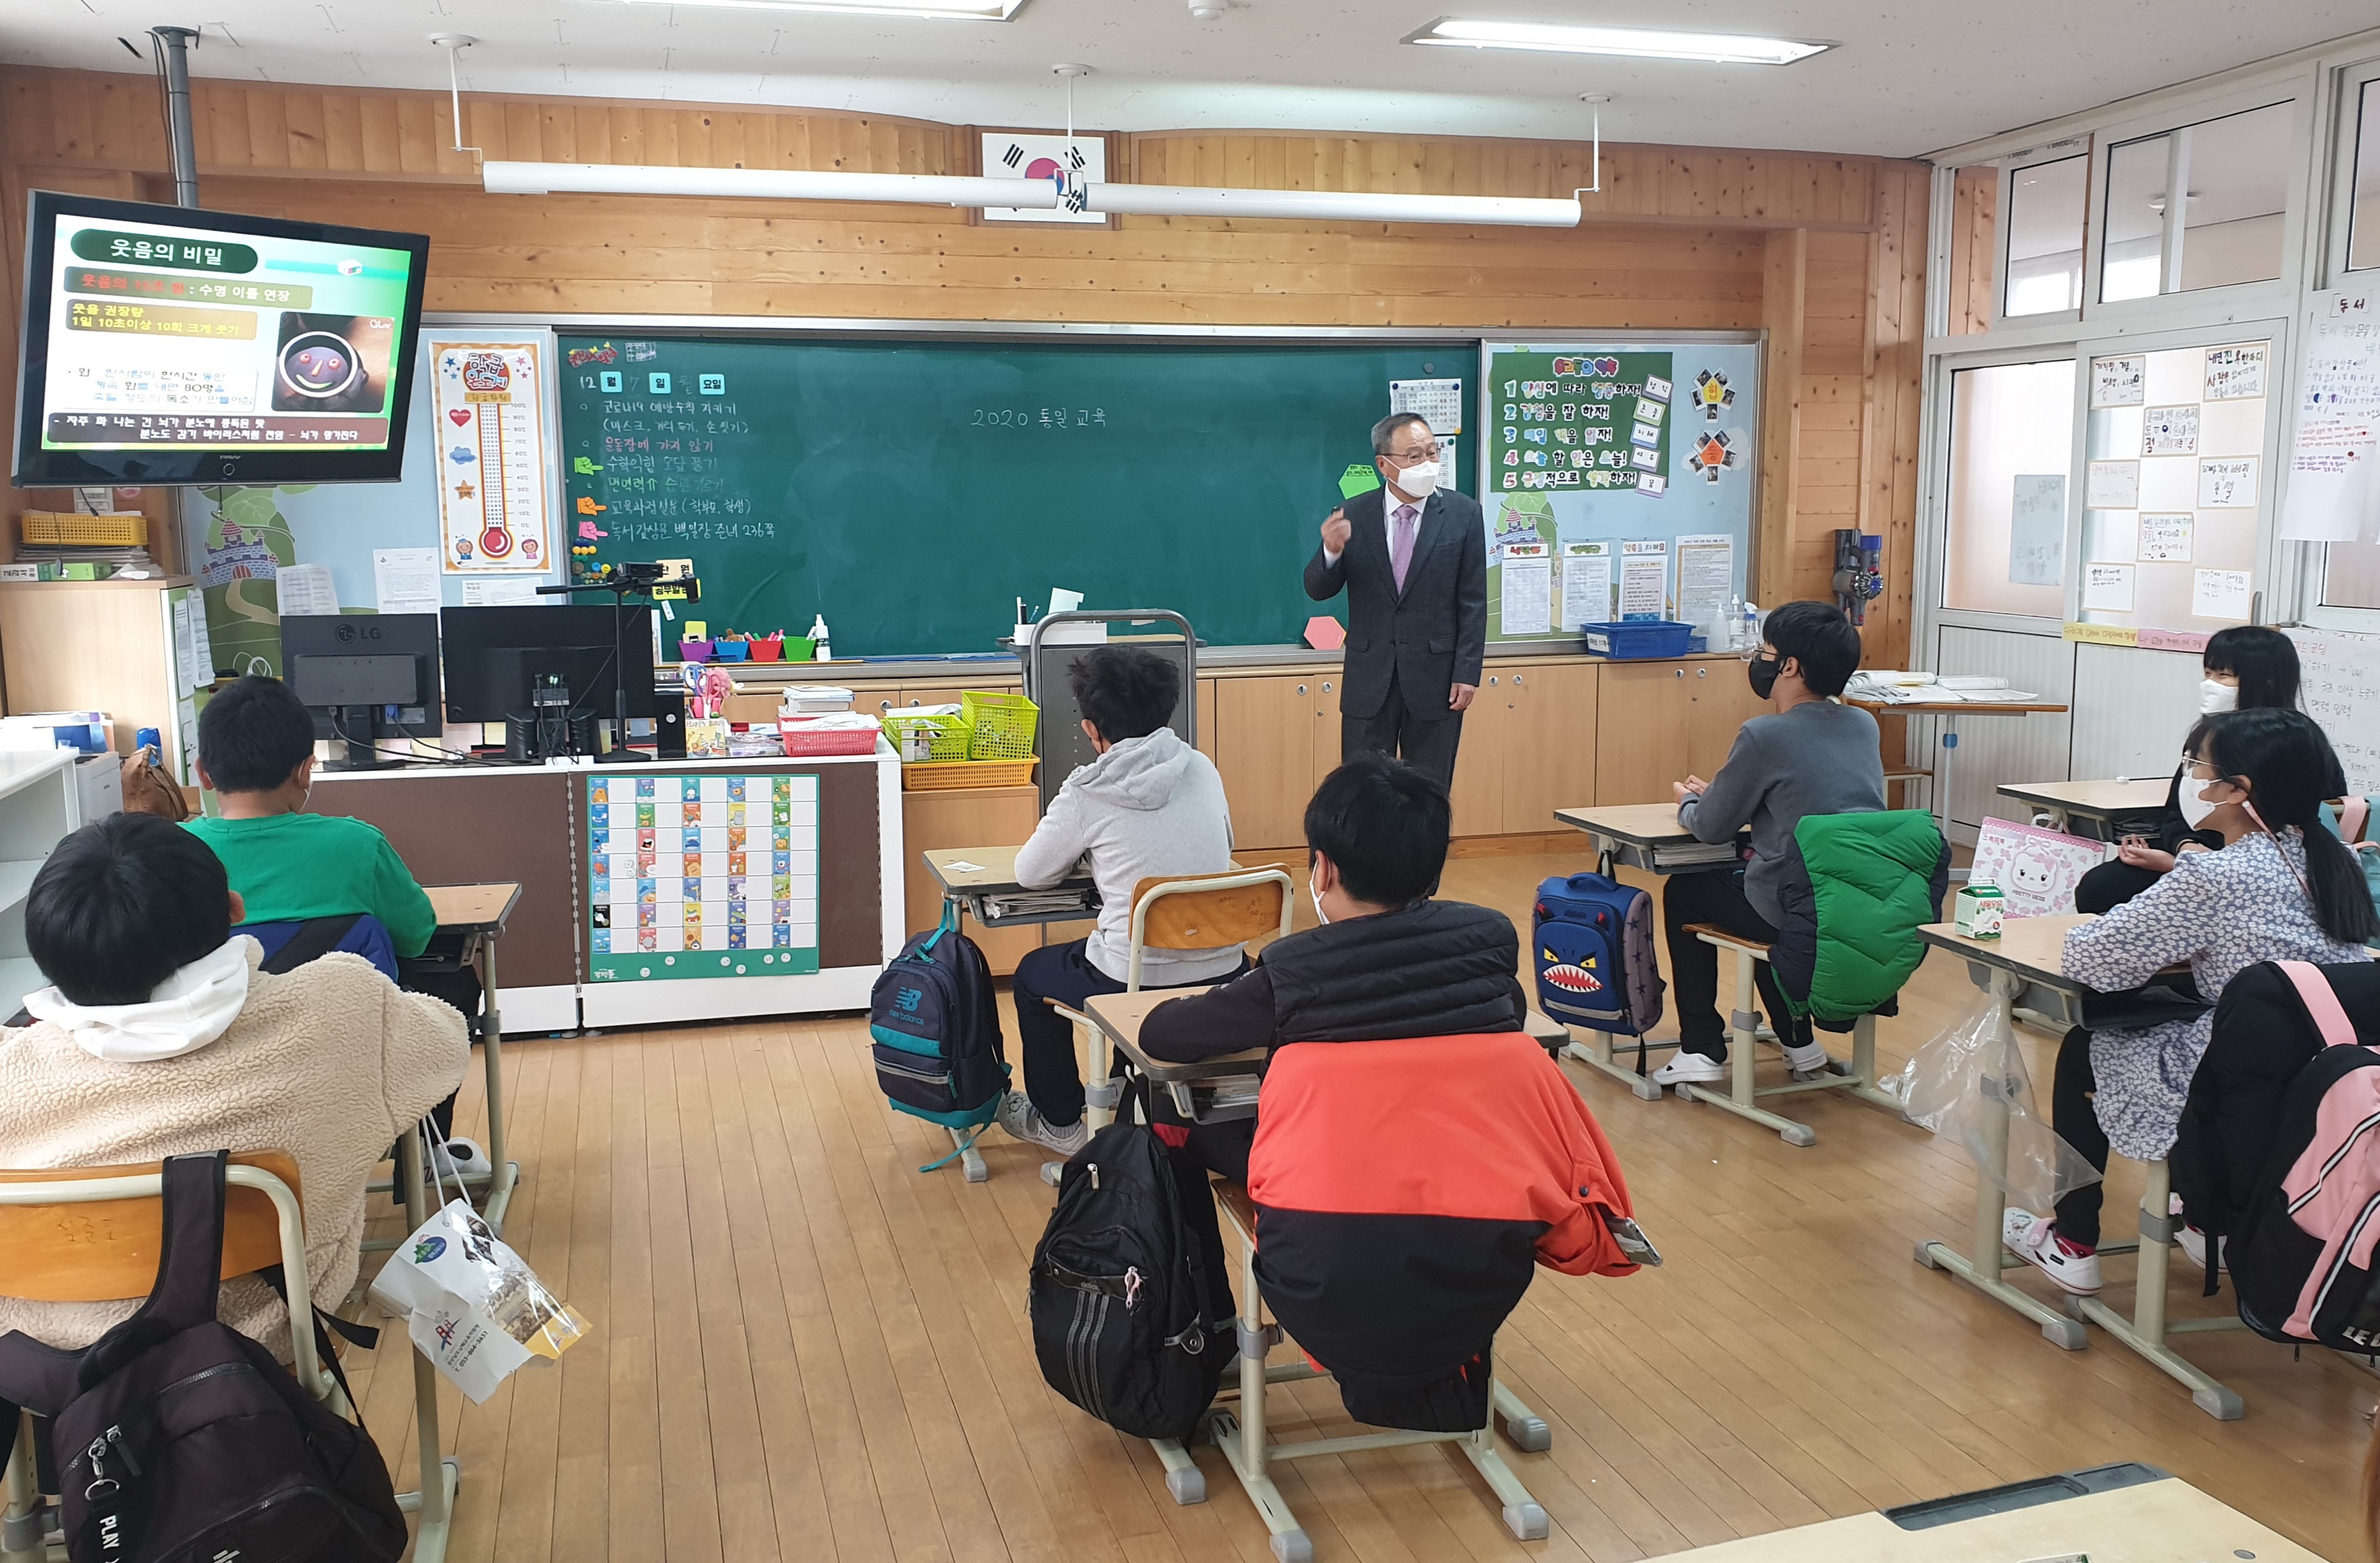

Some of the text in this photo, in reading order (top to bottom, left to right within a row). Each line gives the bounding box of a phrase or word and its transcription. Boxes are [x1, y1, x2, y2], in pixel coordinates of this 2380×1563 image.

[110, 238, 222, 266] 웃음의 비밀
[82, 274, 127, 289] 웃음의
[199, 284, 227, 298] 수명
[264, 288, 290, 302] 연장
[73, 303, 144, 318] 웃음 권장량
[72, 316, 239, 336] 1일 10초이상 10회 크게 웃기
[468, 353, 503, 374] 학급
[161, 371, 197, 381] 한시간
[466, 371, 507, 388] 온도계
[580, 376, 597, 388] 12
[656, 378, 665, 388] 일
[703, 379, 721, 390] 요일
[1505, 381, 1641, 399] 1 양심에 따라 행동하자!
[603, 400, 737, 415] 코로나19 예방수칙 지키기
[1504, 405, 1517, 420] 2
[1563, 405, 1574, 420] 잘
[1583, 405, 1609, 419] 하자!
[66, 416, 88, 427] 자주
[95, 416, 107, 427] 화
[114, 416, 135, 427] 나는
[142, 417, 152, 427] 건
[158, 417, 179, 427] 뇌가
[186, 418, 215, 428] 분노에
[971, 407, 1106, 429] 2020 통일 교육
[140, 429, 170, 439] 분노도
[177, 429, 196, 440] 감기
[203, 430, 260, 440] 바이러스처럼
[265, 430, 284, 440] 전염
[300, 431, 318, 440] 뇌가
[1504, 427, 1517, 443] 3
[1524, 429, 1547, 444] 매일
[1554, 428, 1578, 444] 책을
[605, 436, 649, 452] 운동장에
[657, 438, 681, 451] 가지
[607, 454, 655, 473] 수학익힘
[1504, 450, 1518, 466] 4
[1524, 450, 1547, 466] 오늘
[1553, 451, 1564, 466] 할
[1599, 450, 1627, 467] 오늘!
[1504, 472, 1517, 487] 5
[1586, 470, 1636, 487] 생각하자!
[361, 628, 381, 639] LG
[2338, 685, 2354, 697] 이상
[889, 1009, 924, 1026] new balance
[99, 1515, 120, 1550] PLAY
